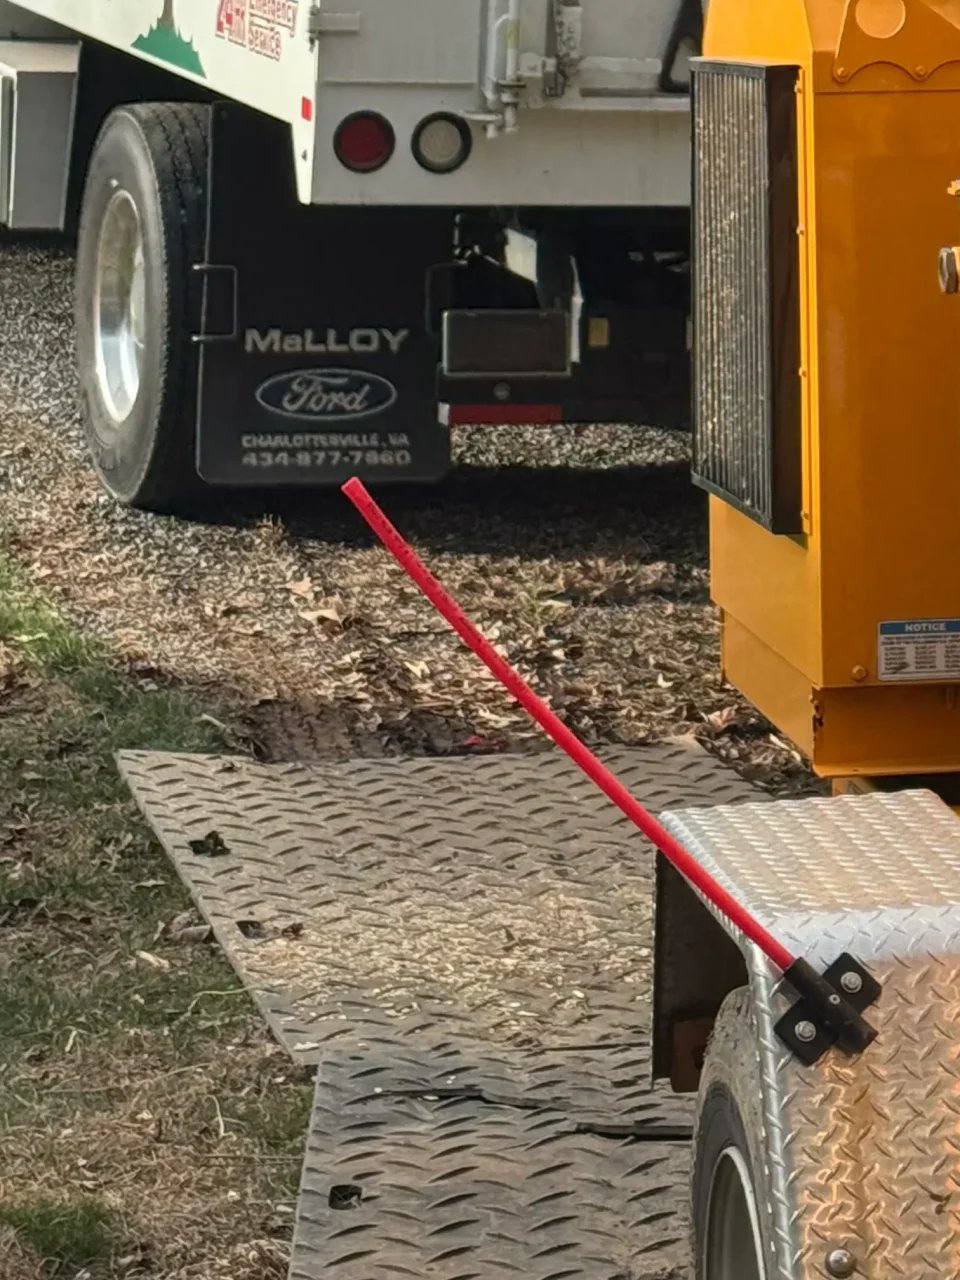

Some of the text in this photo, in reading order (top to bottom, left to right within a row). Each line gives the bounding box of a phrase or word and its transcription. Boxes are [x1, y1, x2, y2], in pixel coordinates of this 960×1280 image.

[248, 20, 282, 63] Service
[245, 327, 409, 354] MaLLOY
[281, 372, 371, 412] Ford
[388, 431, 411, 447] VA
[905, 622, 947, 633] NOTICE
